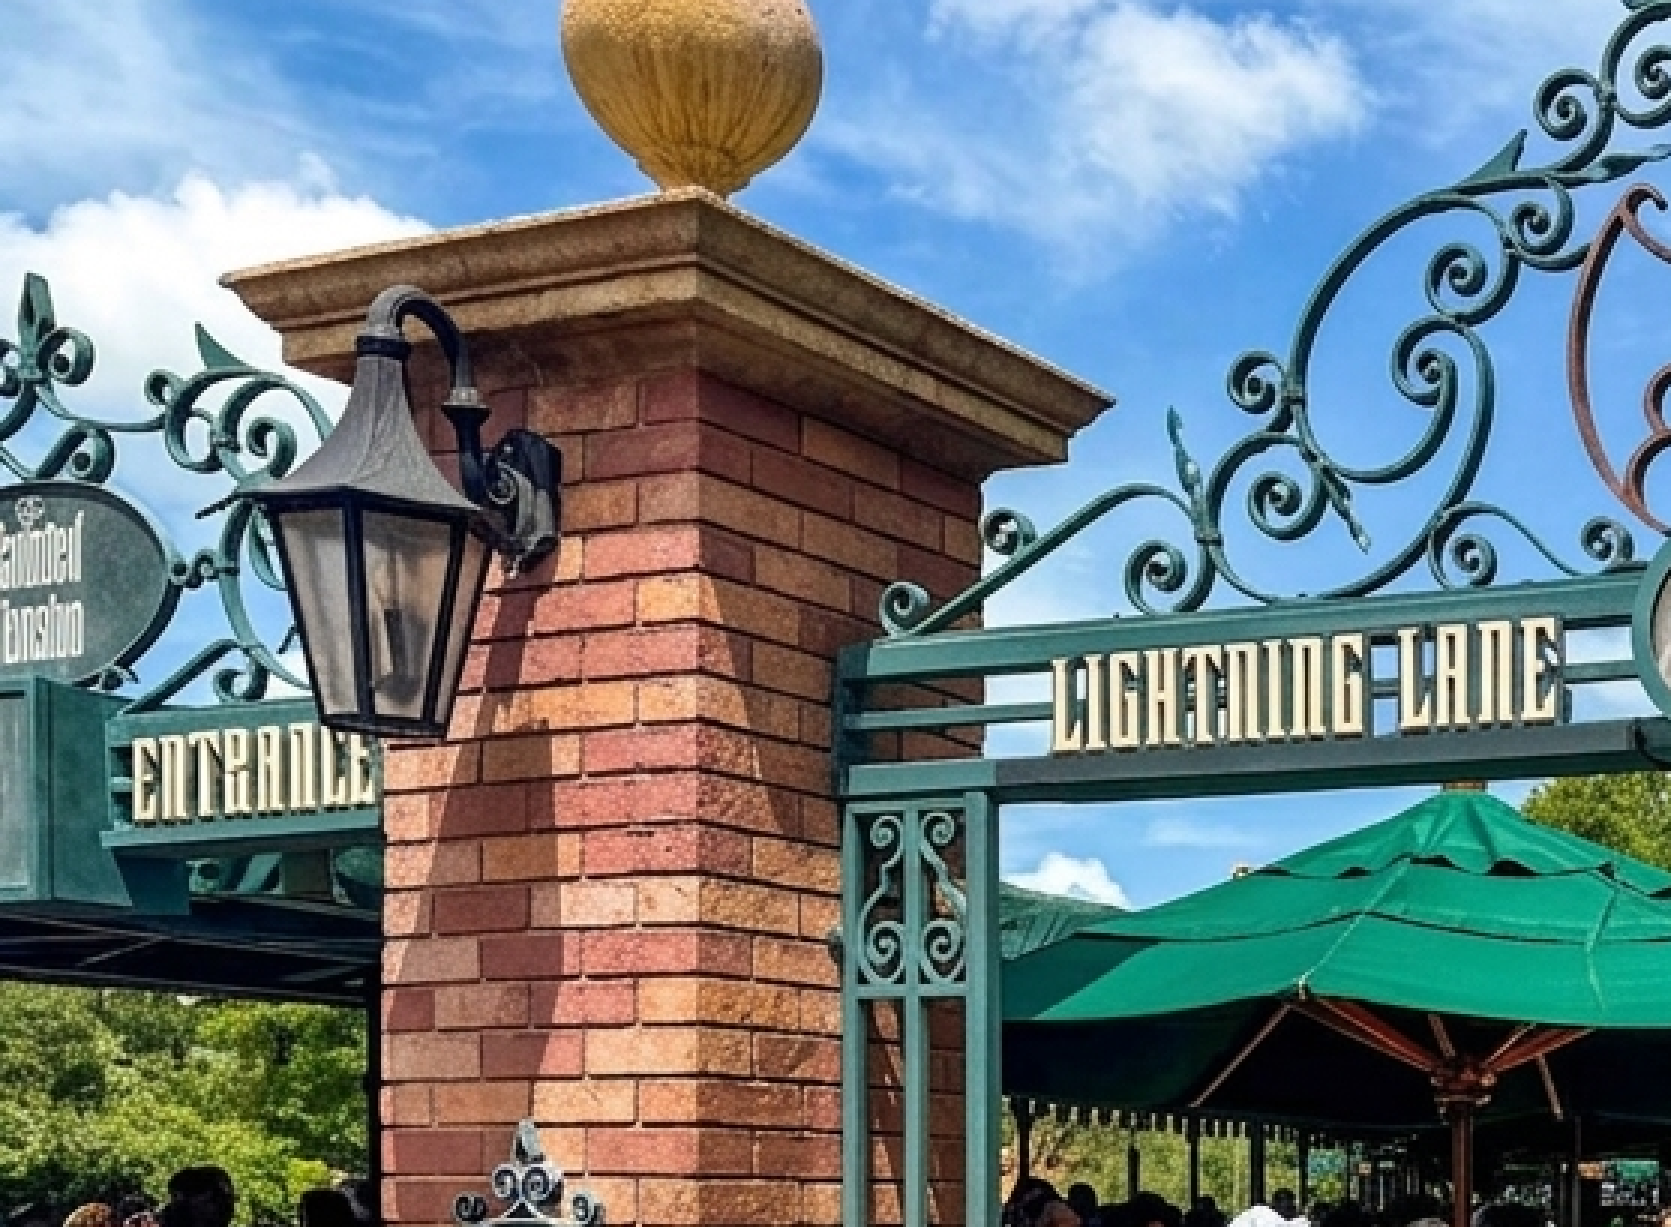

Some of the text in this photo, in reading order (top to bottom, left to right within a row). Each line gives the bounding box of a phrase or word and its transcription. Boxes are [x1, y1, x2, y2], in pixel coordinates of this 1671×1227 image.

[1051, 632, 1365, 754] LIGHTNING
[1398, 616, 1562, 730] LANE
[131, 722, 375, 821] ENTRANCE
